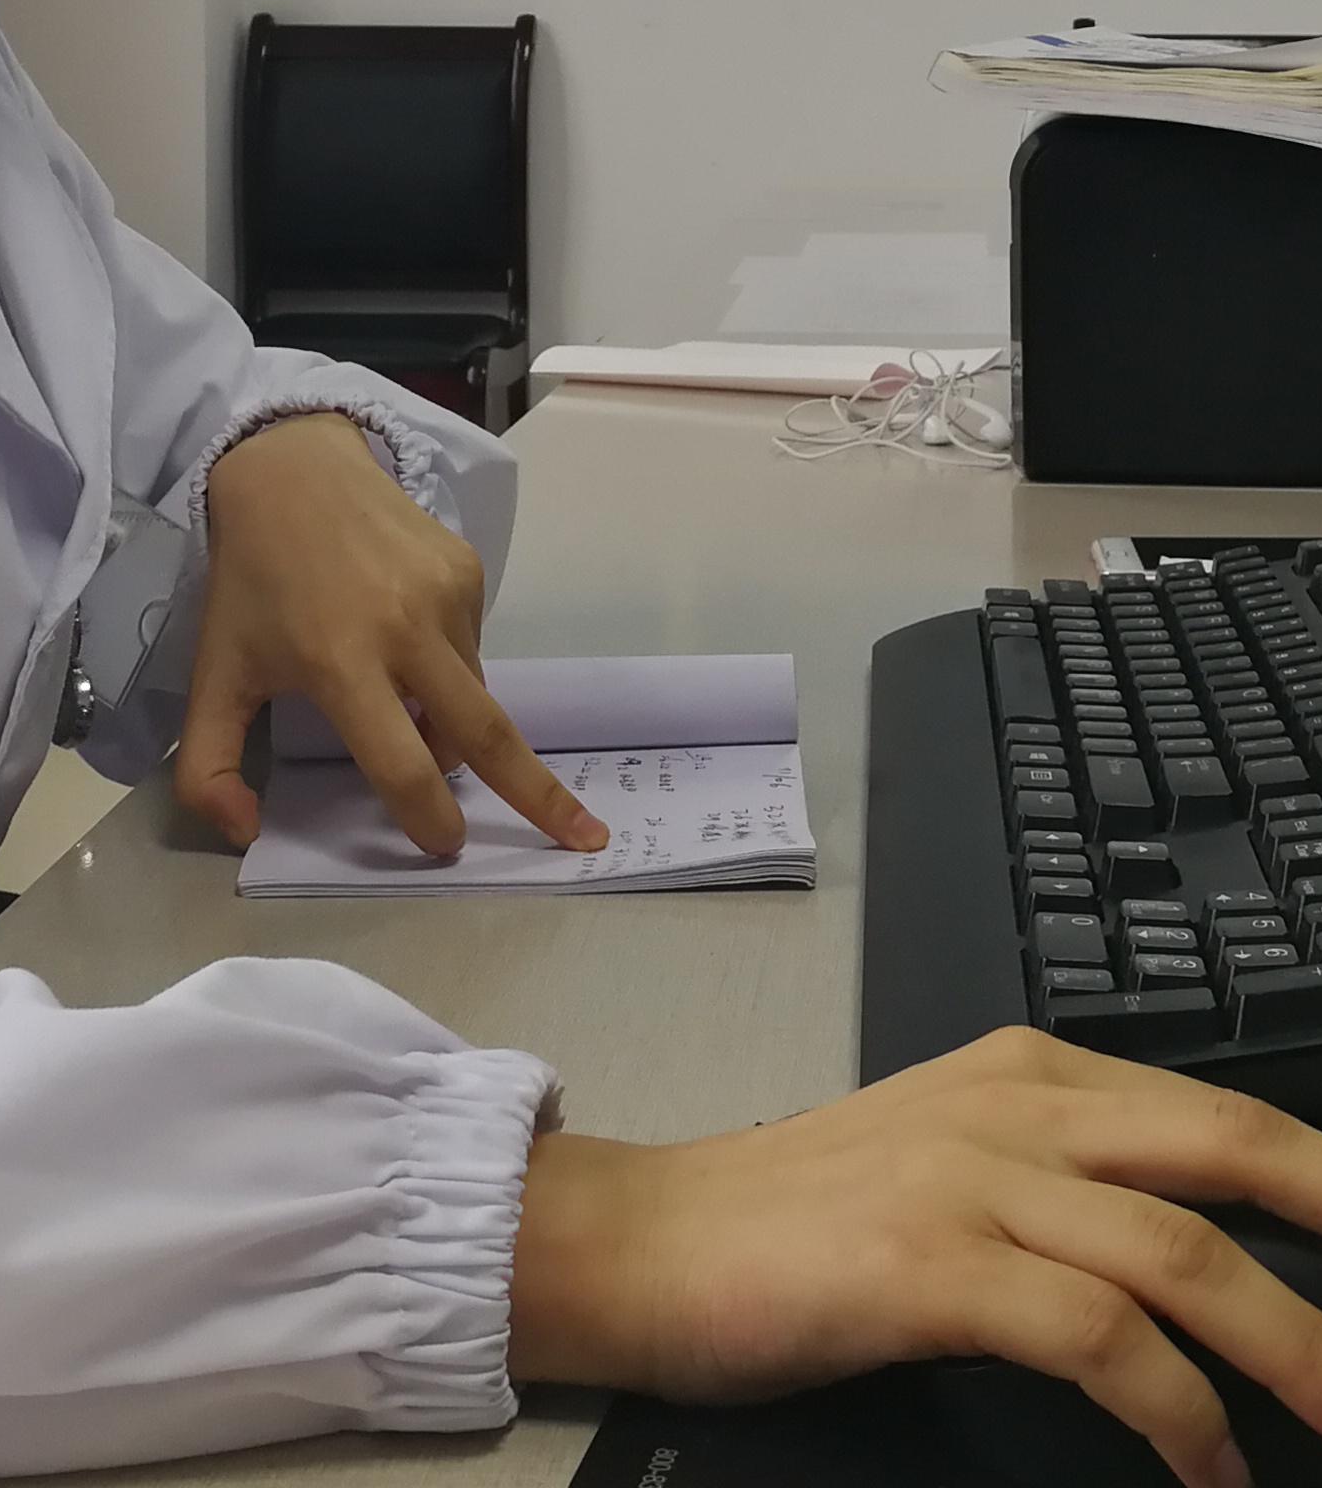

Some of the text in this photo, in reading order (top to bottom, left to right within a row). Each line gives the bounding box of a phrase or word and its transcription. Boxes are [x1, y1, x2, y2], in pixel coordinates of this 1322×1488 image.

[1244, 891, 1268, 901] 4
[1071, 917, 1094, 926] 0
[1252, 919, 1276, 929] 5
[1166, 930, 1189, 941] 2
[1264, 947, 1289, 958] 6
[1173, 959, 1197, 969] 3
